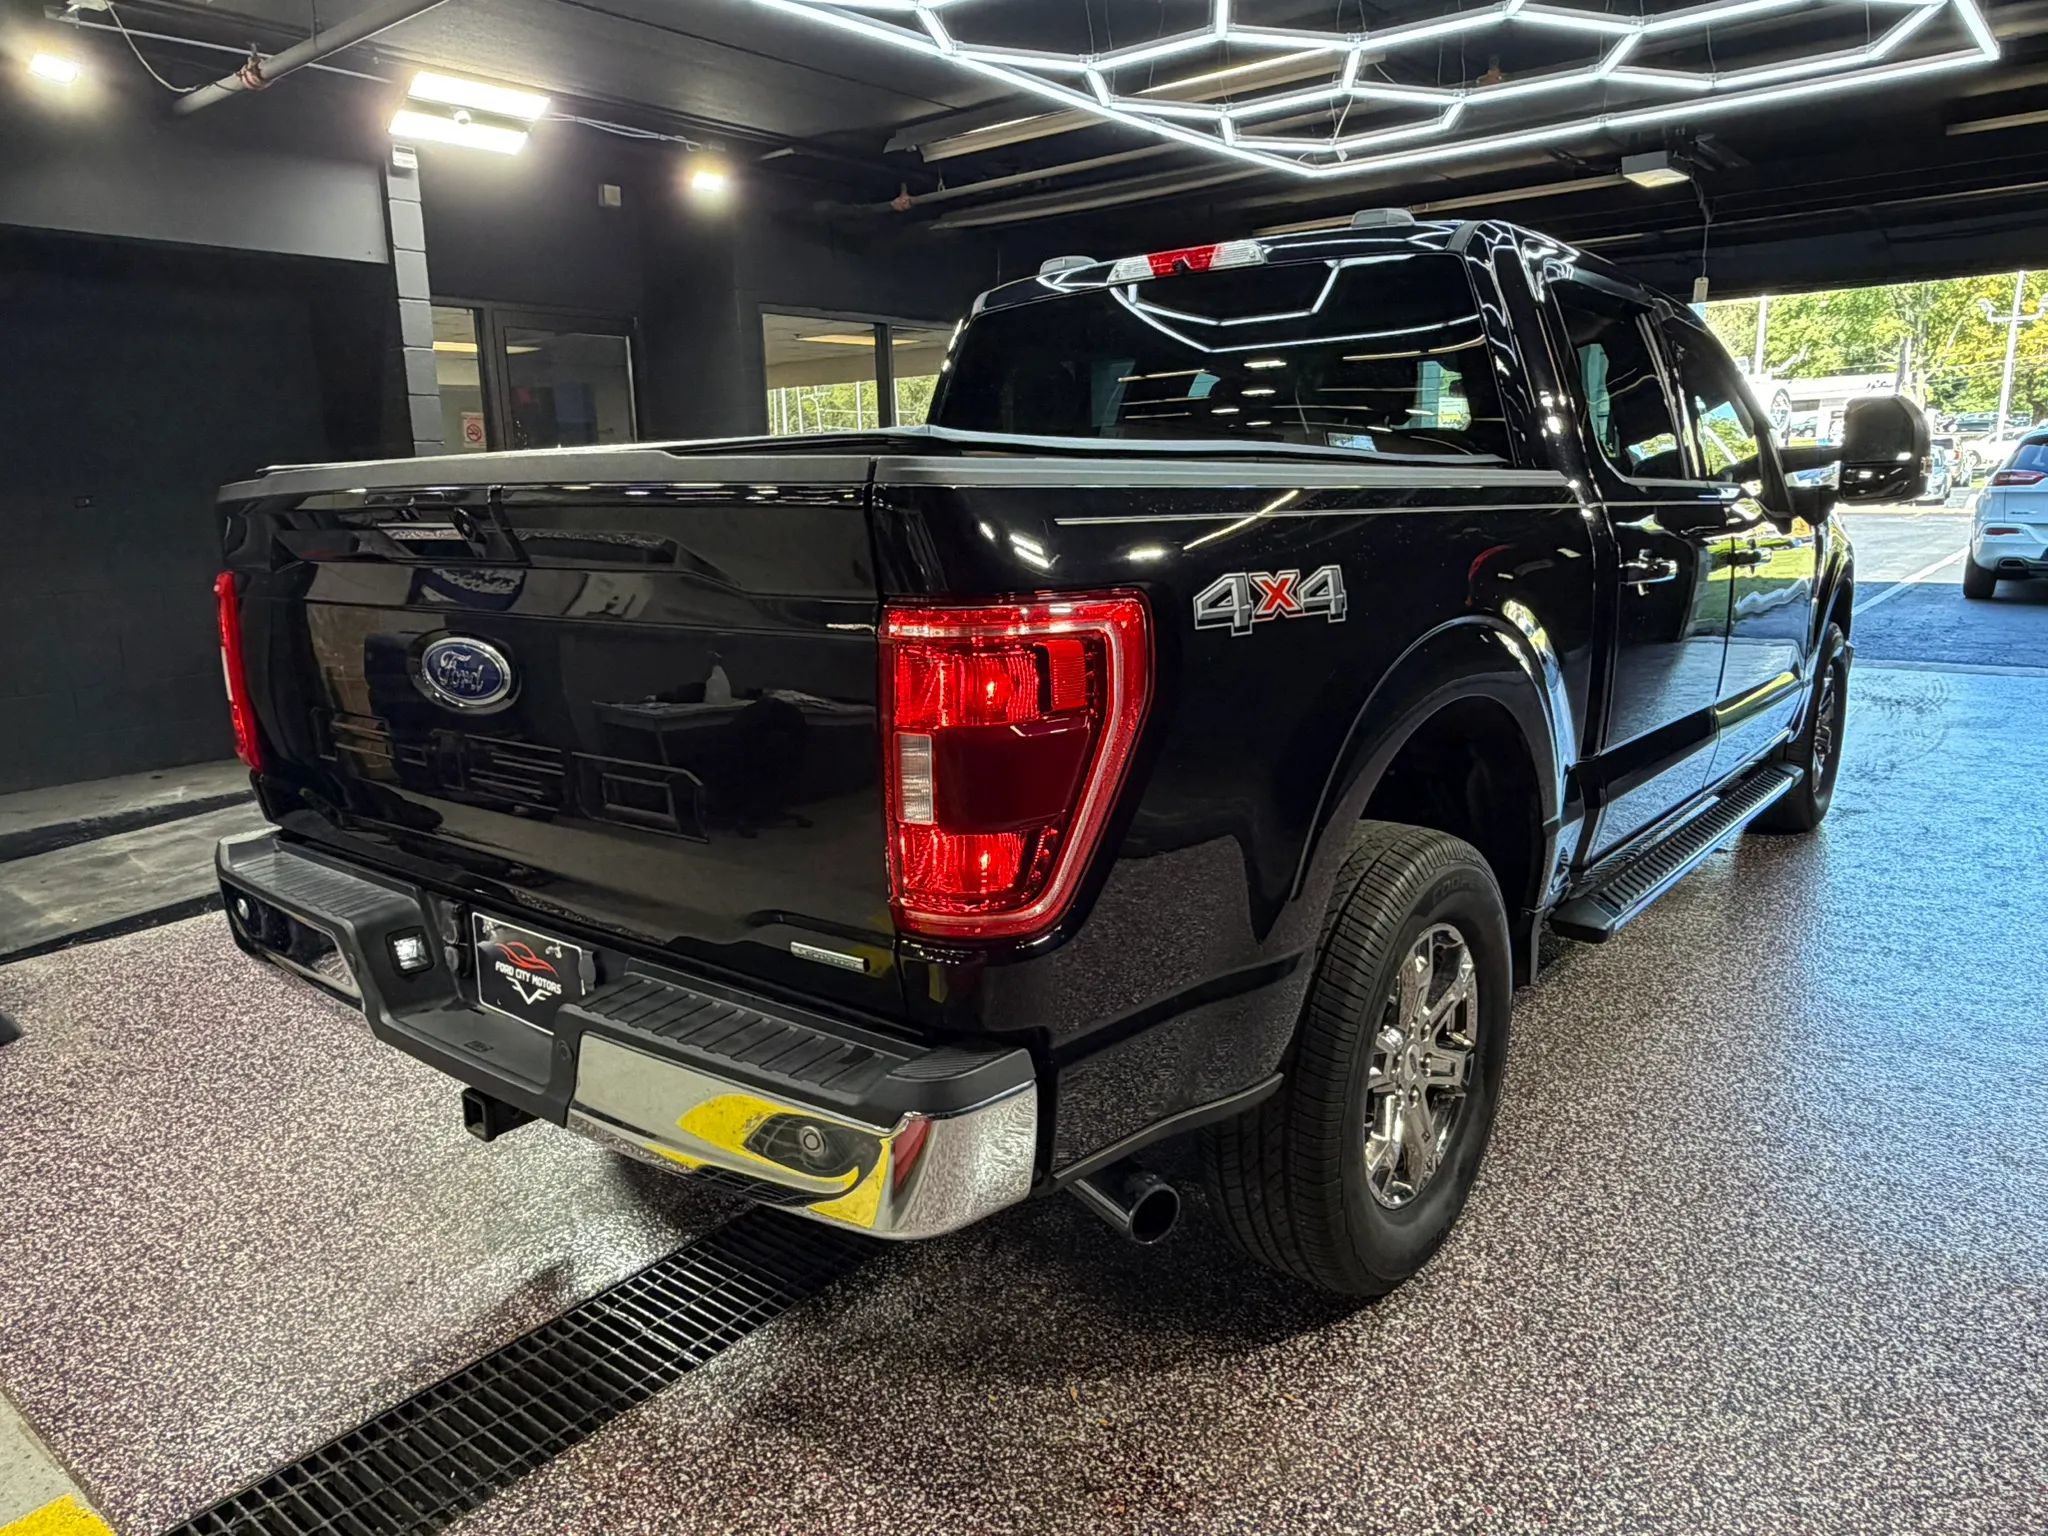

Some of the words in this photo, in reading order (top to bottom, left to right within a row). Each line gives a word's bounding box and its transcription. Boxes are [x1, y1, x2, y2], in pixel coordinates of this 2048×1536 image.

[437, 650, 484, 692] Ford
[495, 961, 515, 976] FORD
[515, 968, 532, 982] CITY
[531, 974, 562, 995] MOTORS
